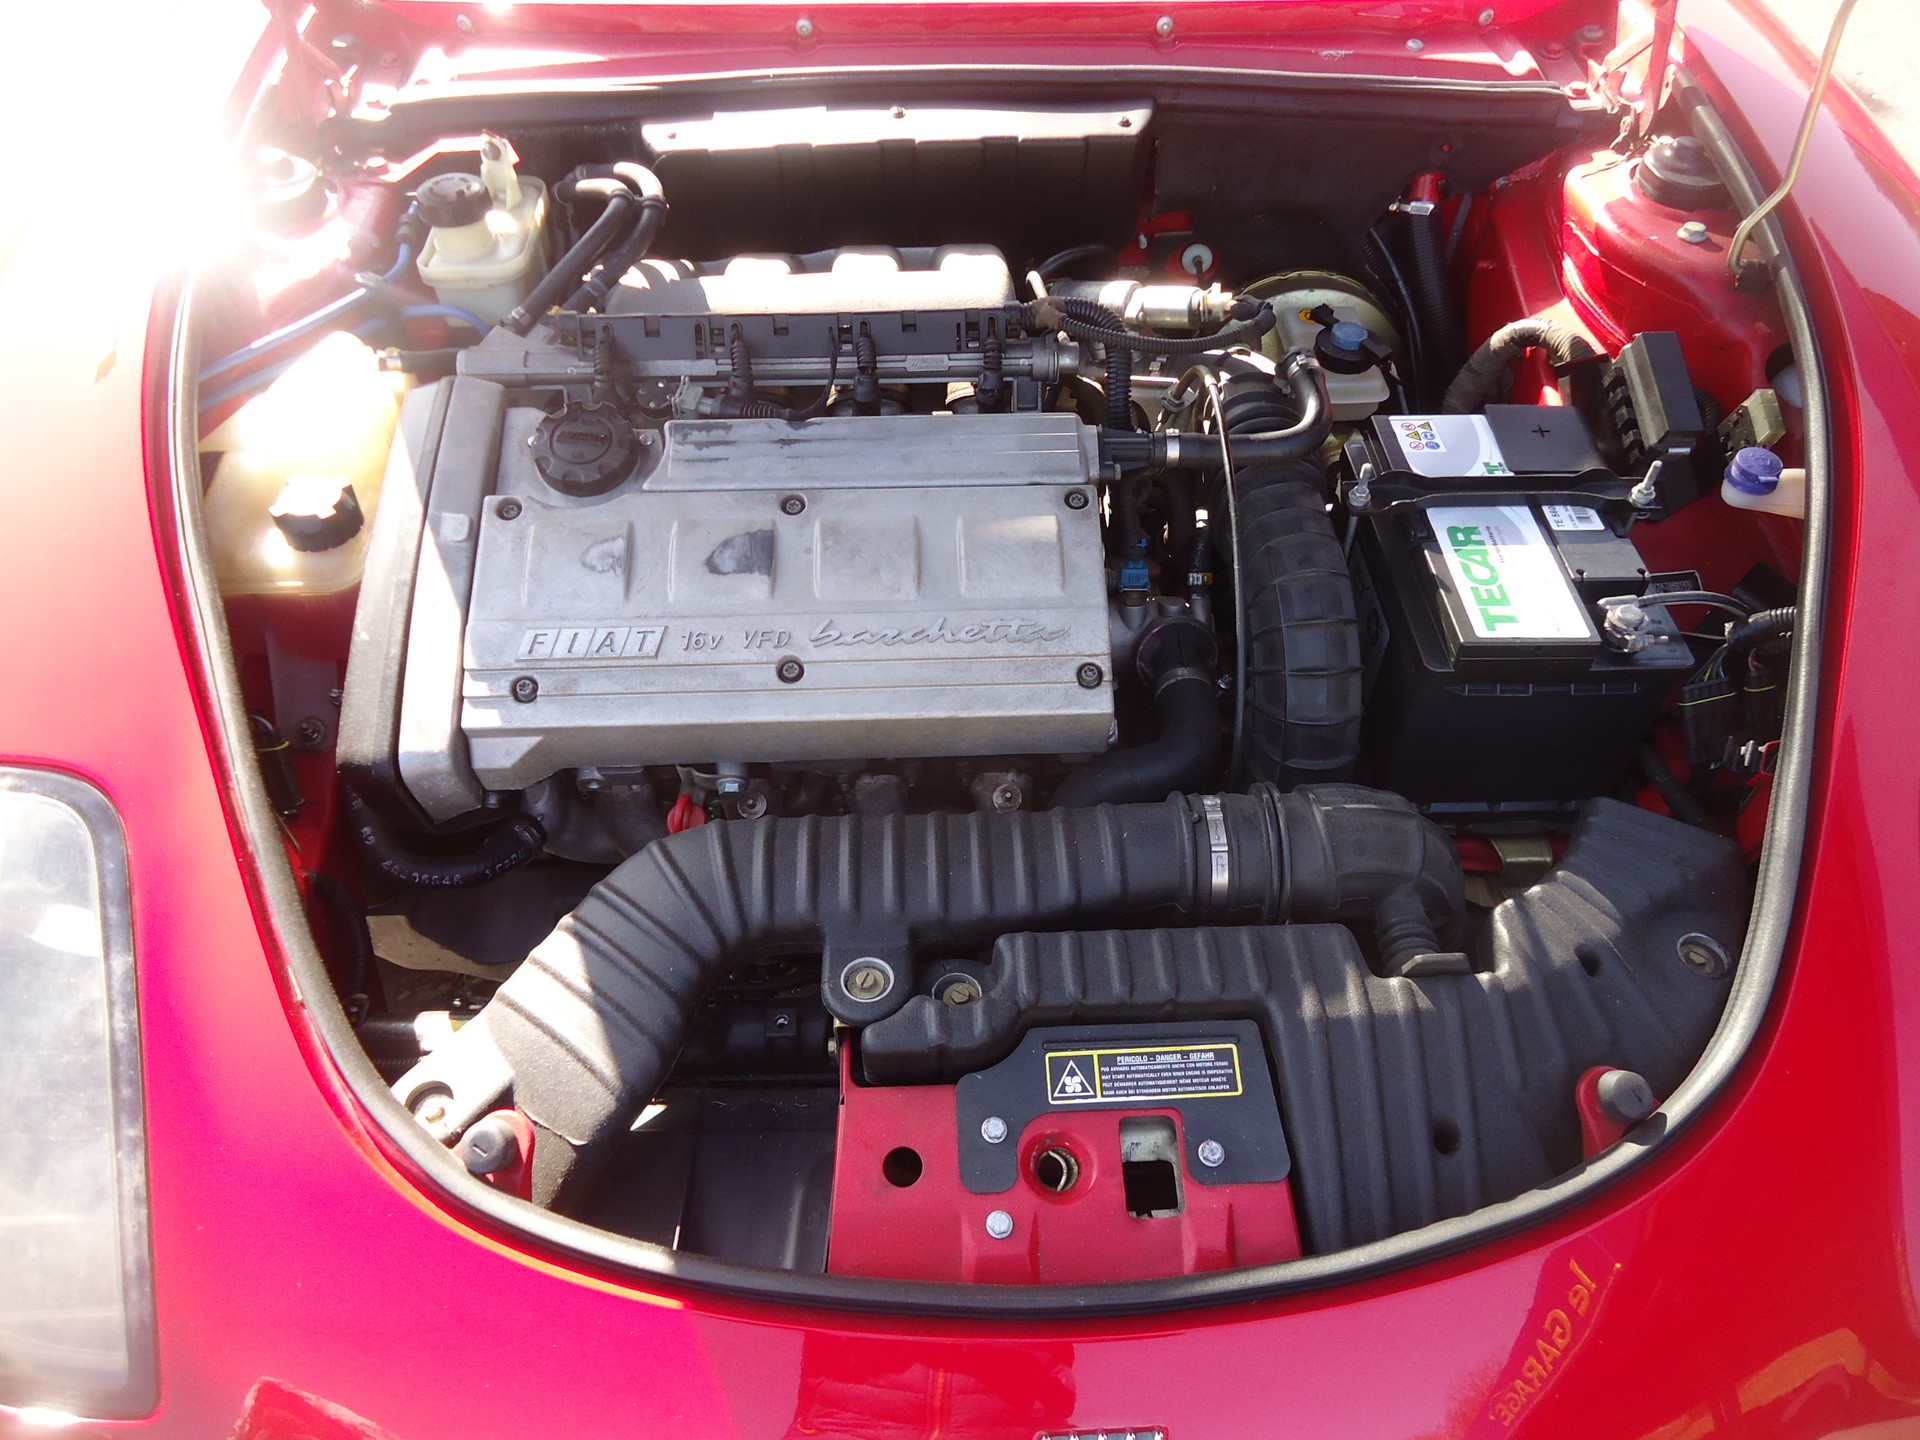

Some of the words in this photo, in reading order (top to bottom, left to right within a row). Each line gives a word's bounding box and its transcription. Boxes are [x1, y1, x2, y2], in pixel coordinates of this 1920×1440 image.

[1446, 525, 1519, 631] TECAR
[526, 630, 657, 655] FIAT
[681, 630, 723, 651] 16v
[742, 629, 791, 649] VFD
[808, 616, 1072, 648] barchetta
[1116, 1055, 1148, 1064] PERICOLO
[1155, 1053, 1182, 1062] DANGER
[1189, 1051, 1215, 1060] GEFAHR
